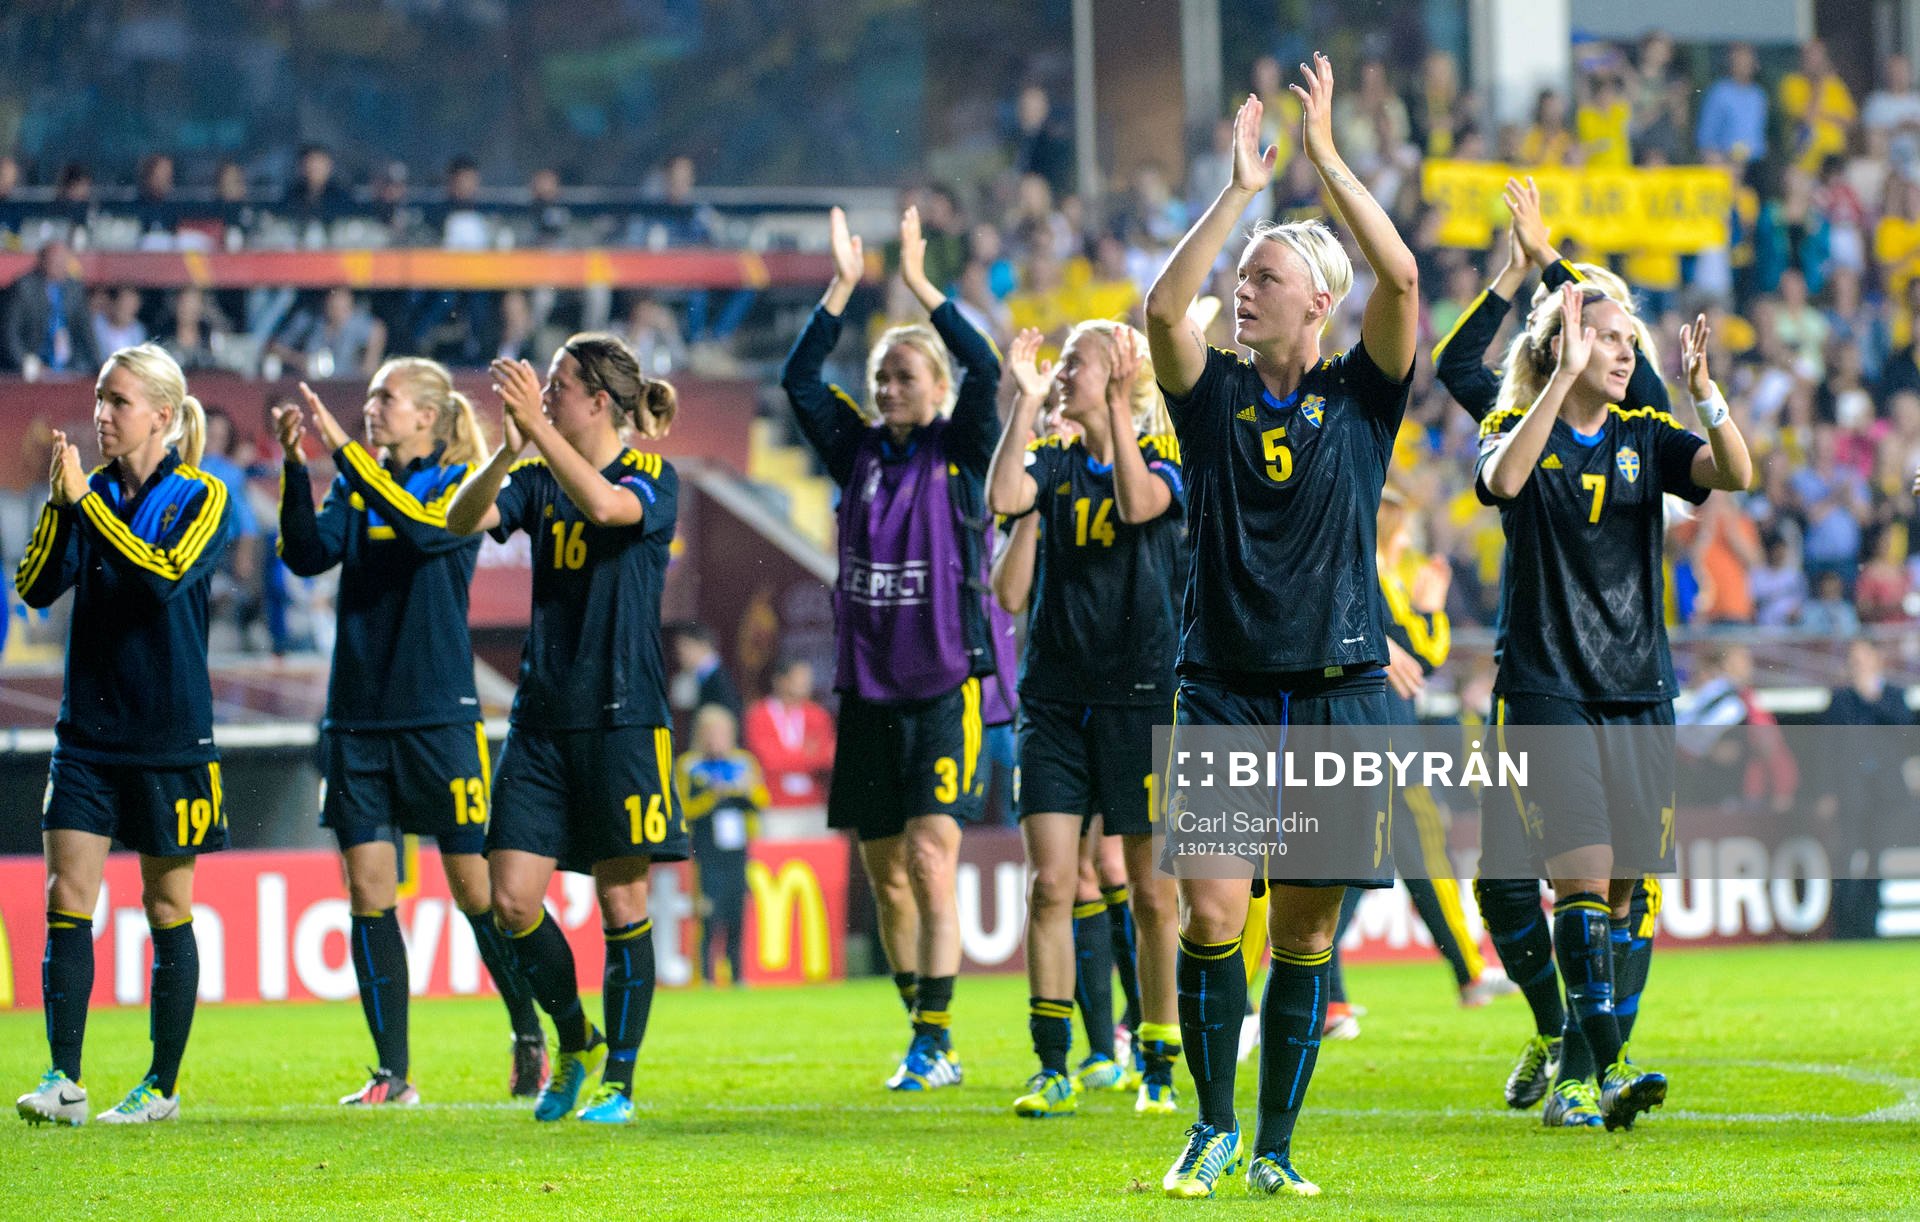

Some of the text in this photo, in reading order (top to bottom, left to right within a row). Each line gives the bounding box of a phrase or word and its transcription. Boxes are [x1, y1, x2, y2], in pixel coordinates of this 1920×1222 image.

[1261, 426, 1293, 482] 5
[1074, 497, 1116, 547] 14
[1581, 473, 1606, 523] 7
[551, 520, 588, 570] 16
[449, 777, 488, 825] 13
[934, 756, 958, 804] 3
[175, 798, 211, 846] 19
[624, 794, 667, 845] 16
